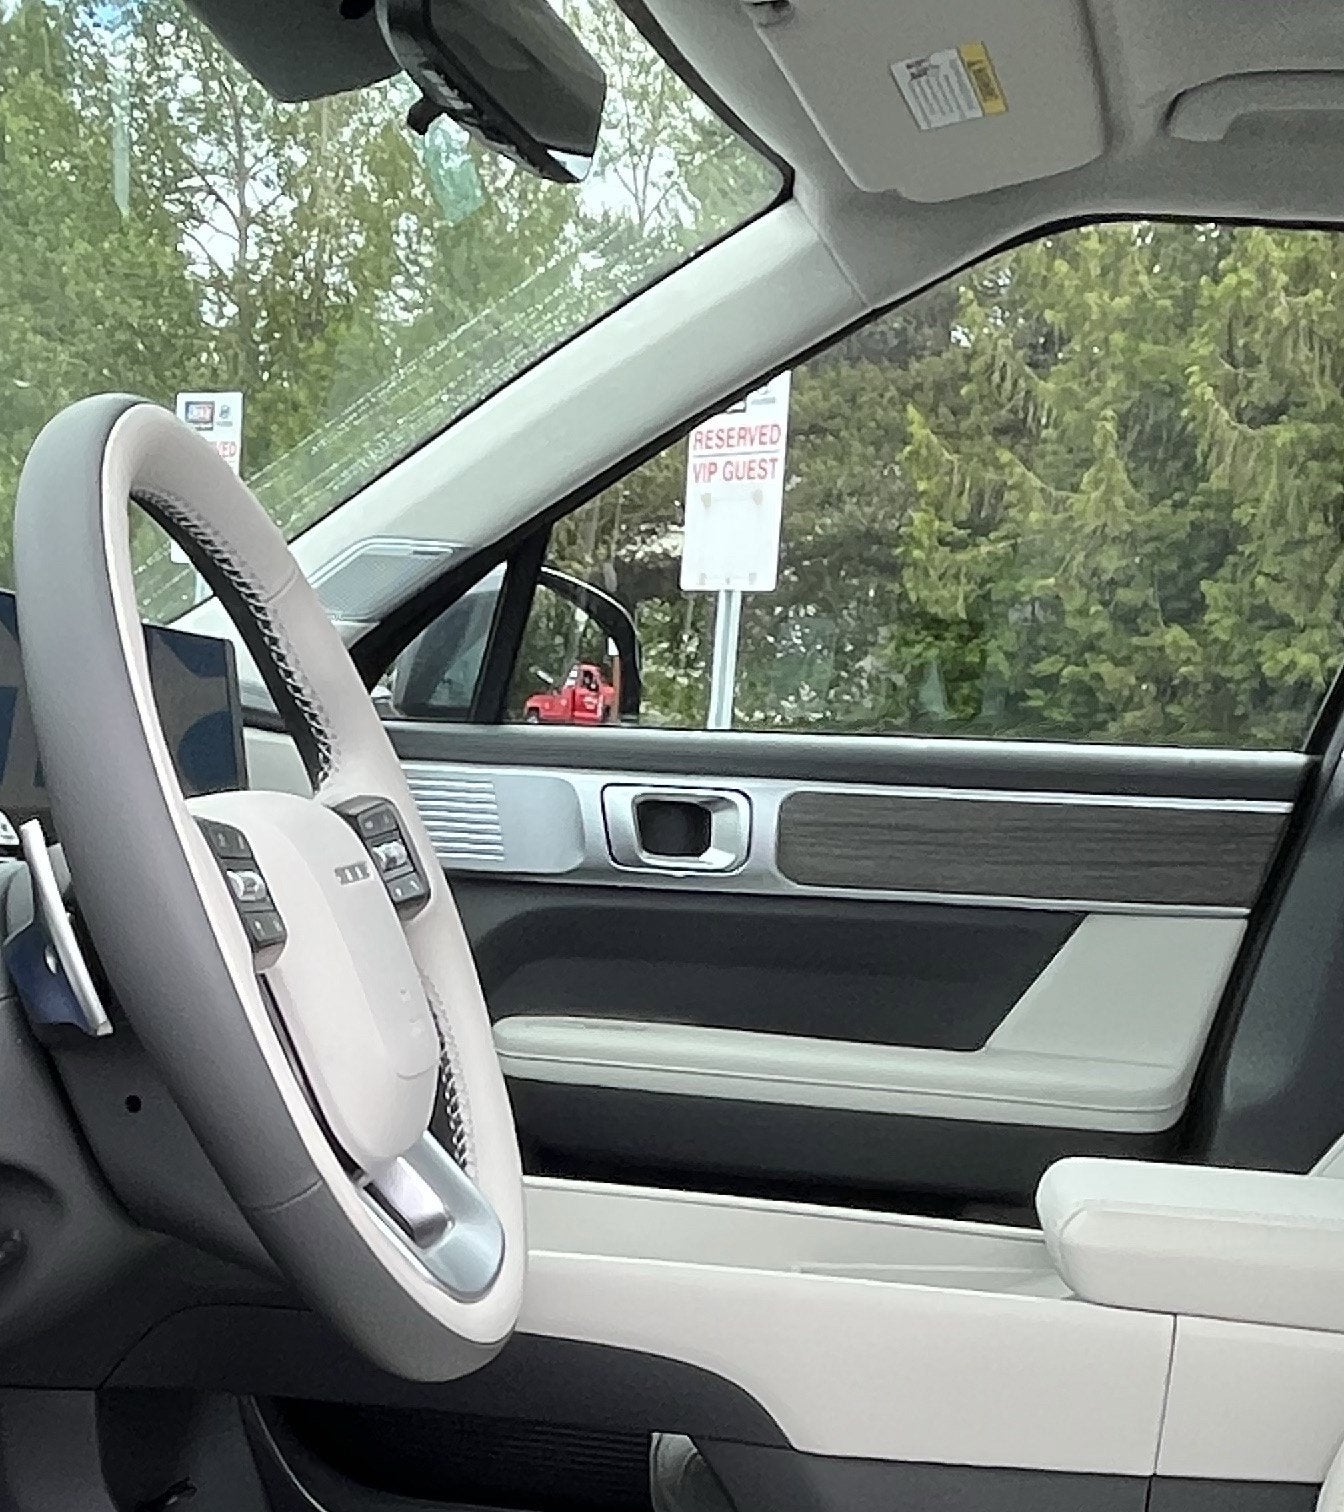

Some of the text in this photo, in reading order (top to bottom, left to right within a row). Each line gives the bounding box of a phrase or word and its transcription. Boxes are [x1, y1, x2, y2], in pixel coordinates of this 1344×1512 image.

[692, 423, 782, 451] RESERVED
[692, 458, 779, 484] VIP GUEST
